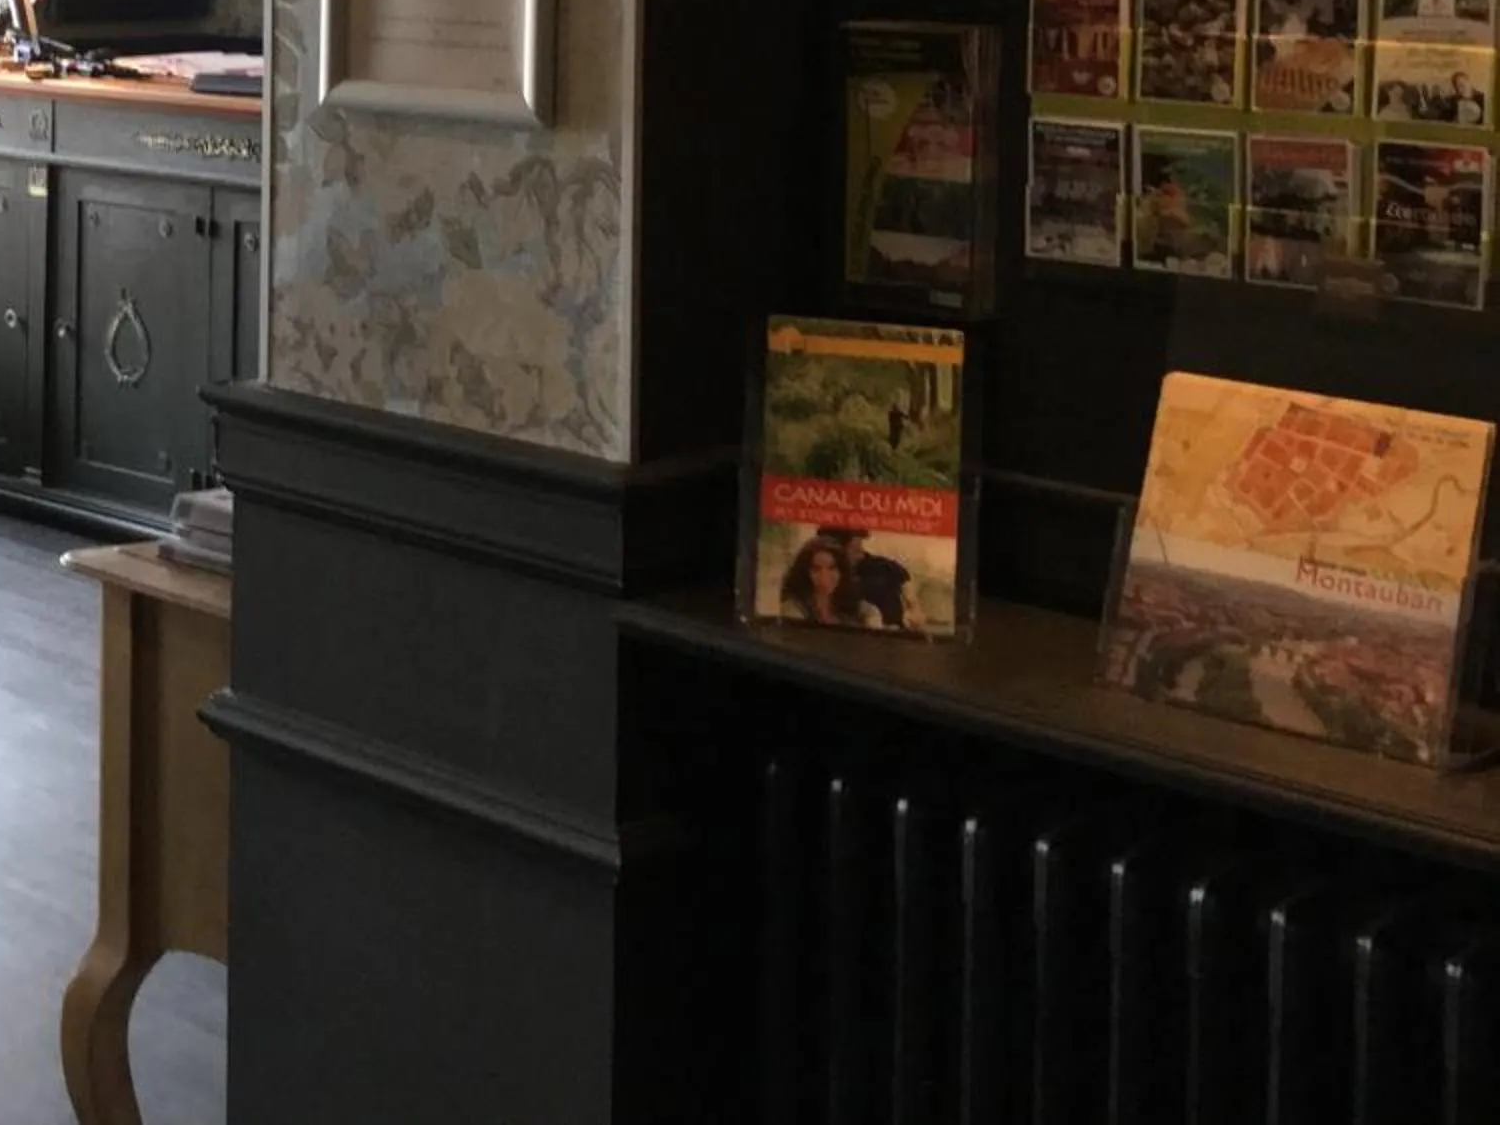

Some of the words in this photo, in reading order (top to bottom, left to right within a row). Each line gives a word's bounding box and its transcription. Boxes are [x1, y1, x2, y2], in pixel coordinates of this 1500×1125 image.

[775, 483, 854, 510] CANAL
[860, 491, 891, 512] DU
[895, 495, 944, 518] MIDI
[1297, 555, 1443, 613] Montauban
